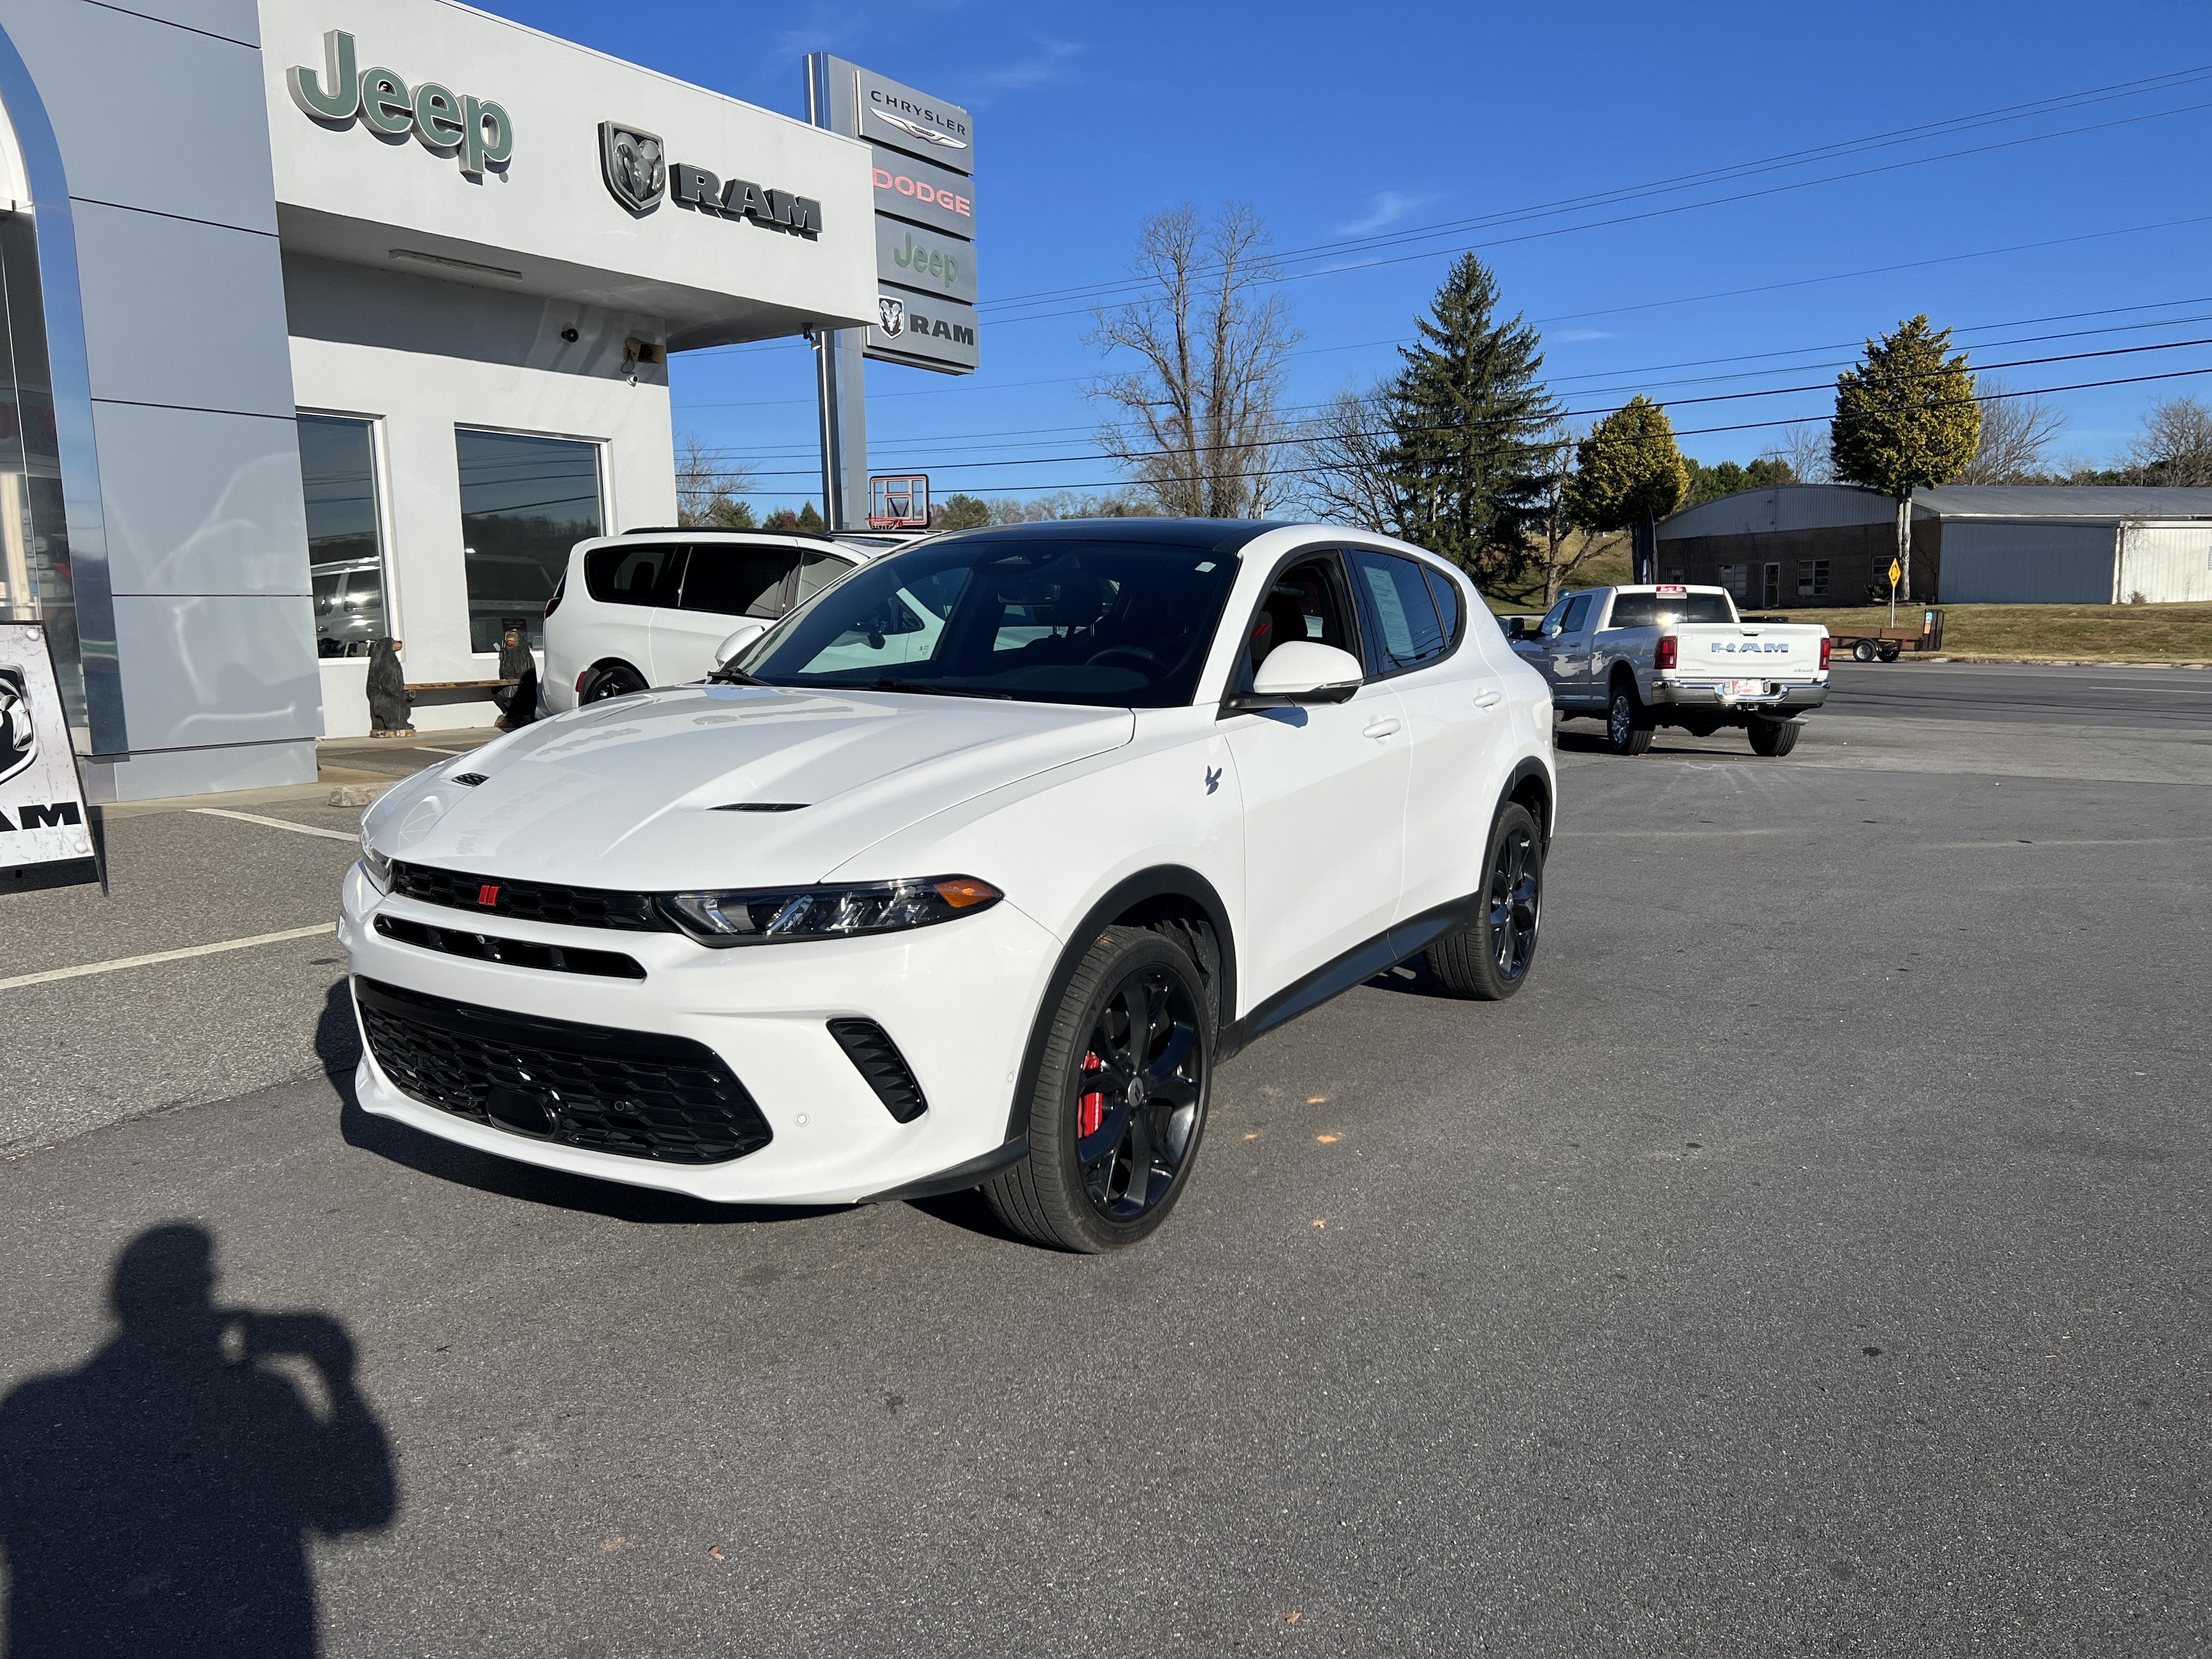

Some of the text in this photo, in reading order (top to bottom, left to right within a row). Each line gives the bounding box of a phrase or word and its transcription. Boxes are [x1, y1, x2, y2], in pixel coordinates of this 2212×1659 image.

[286, 29, 515, 174] Jeep
[871, 91, 966, 136] CHRYSLER
[669, 163, 823, 233] RAM
[872, 167, 970, 217] DODGE
[893, 232, 959, 288] Jeep
[910, 314, 974, 346] RAM
[1711, 643, 1788, 653] RAM
